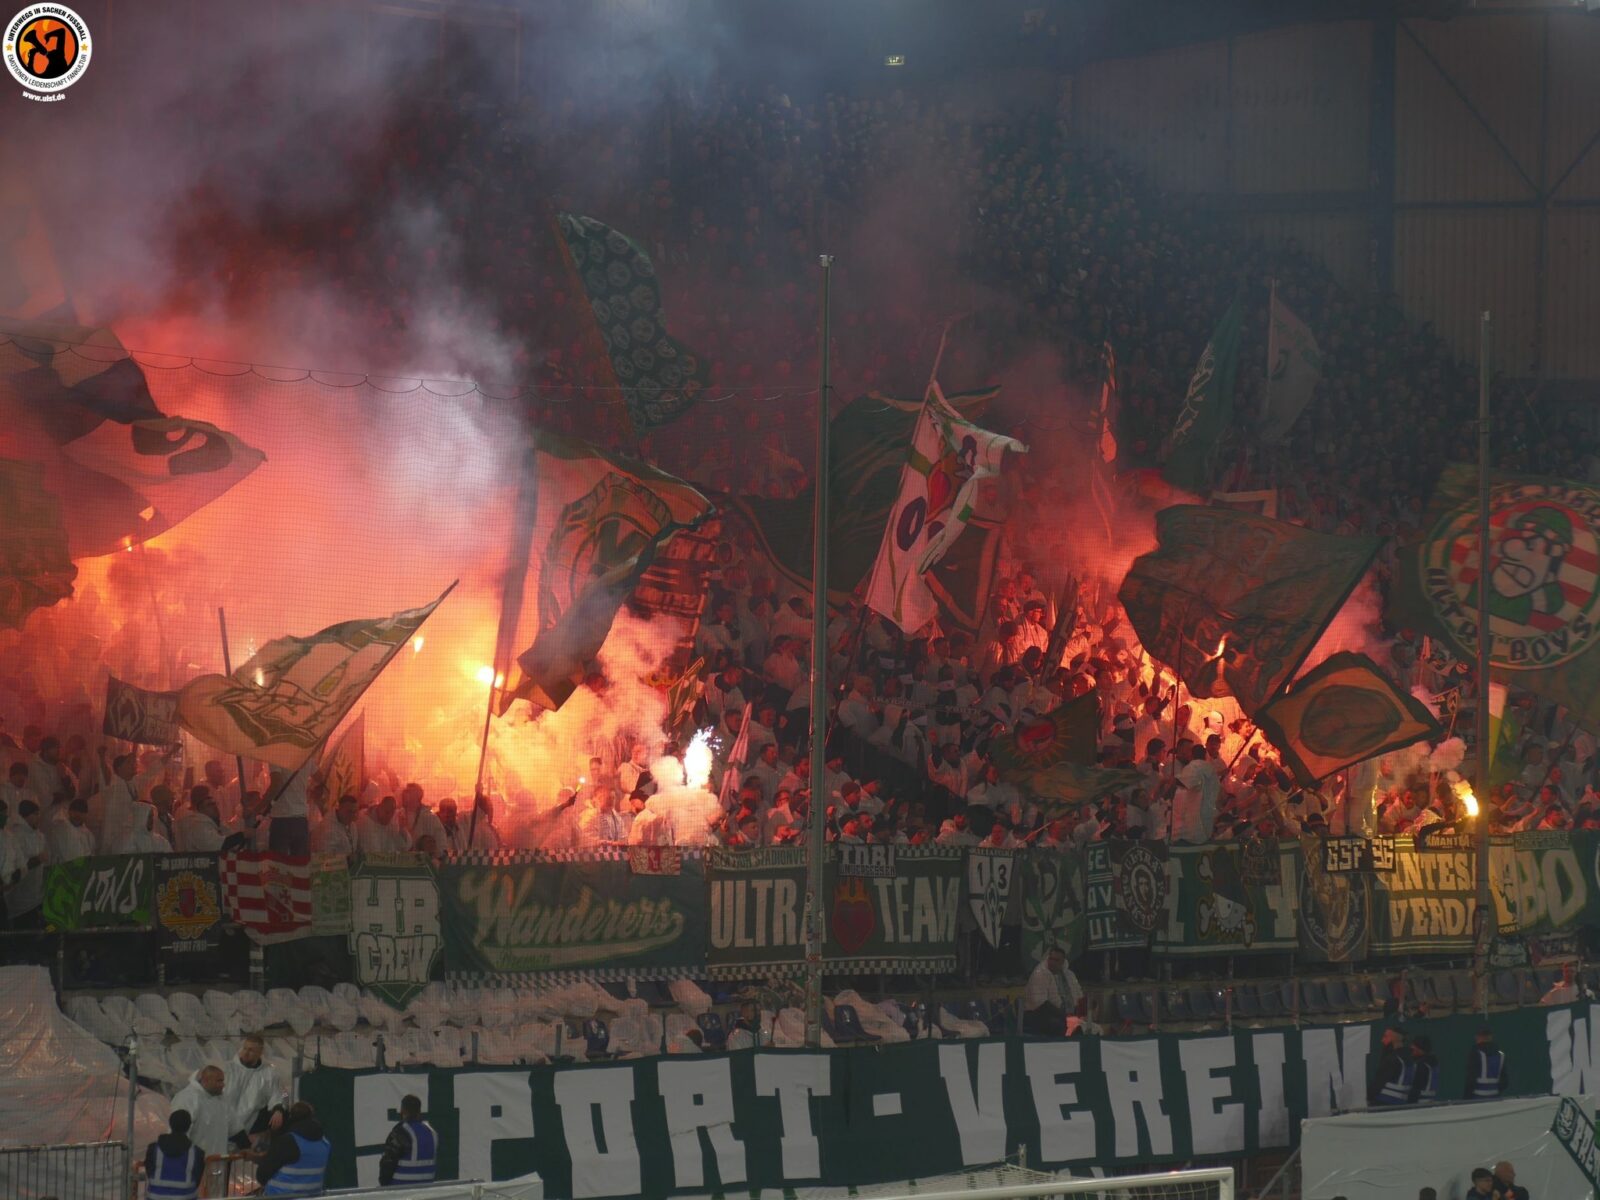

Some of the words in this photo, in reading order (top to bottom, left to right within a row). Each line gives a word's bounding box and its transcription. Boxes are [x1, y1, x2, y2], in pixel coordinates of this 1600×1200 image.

[1507, 613, 1593, 662] BOYS
[459, 866, 674, 947] Wanderers
[873, 876, 960, 944] TEAM
[356, 932, 438, 986] CREW
